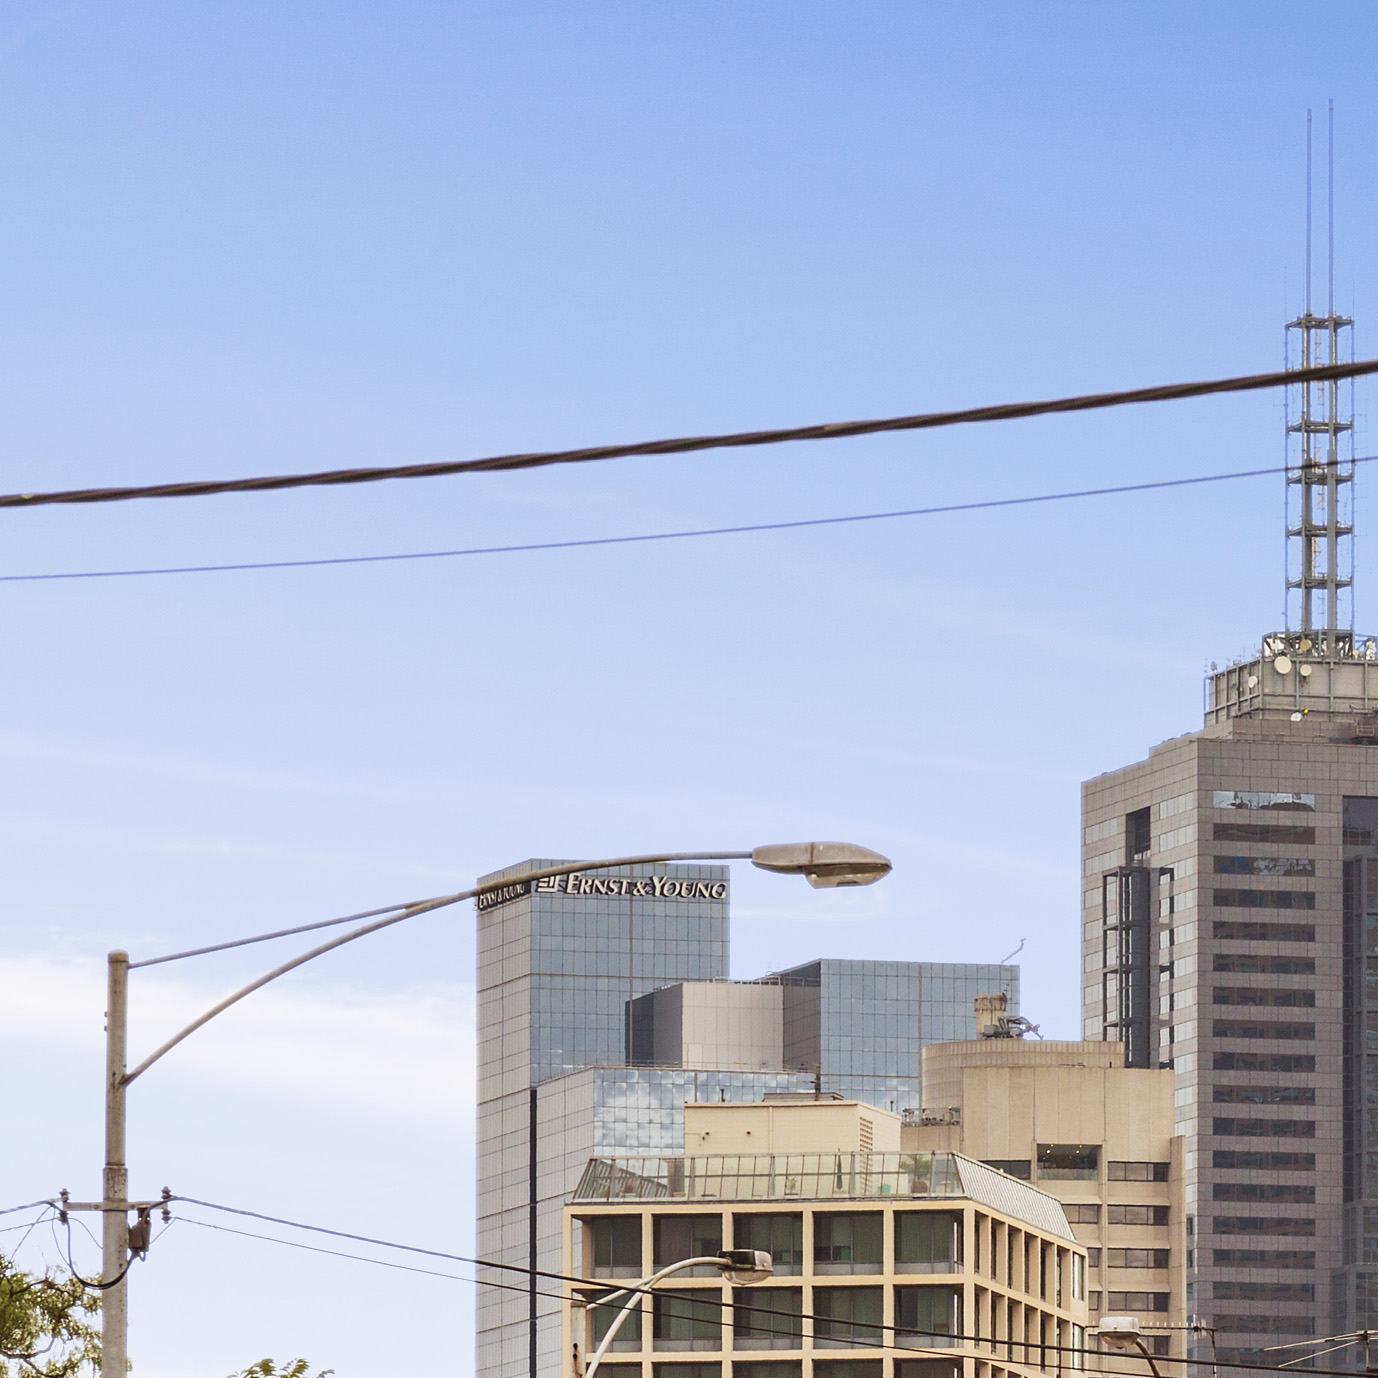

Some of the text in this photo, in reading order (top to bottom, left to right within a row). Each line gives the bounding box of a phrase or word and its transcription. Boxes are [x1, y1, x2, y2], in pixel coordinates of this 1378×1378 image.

[566, 873, 727, 899] ERNST & YOUNG
